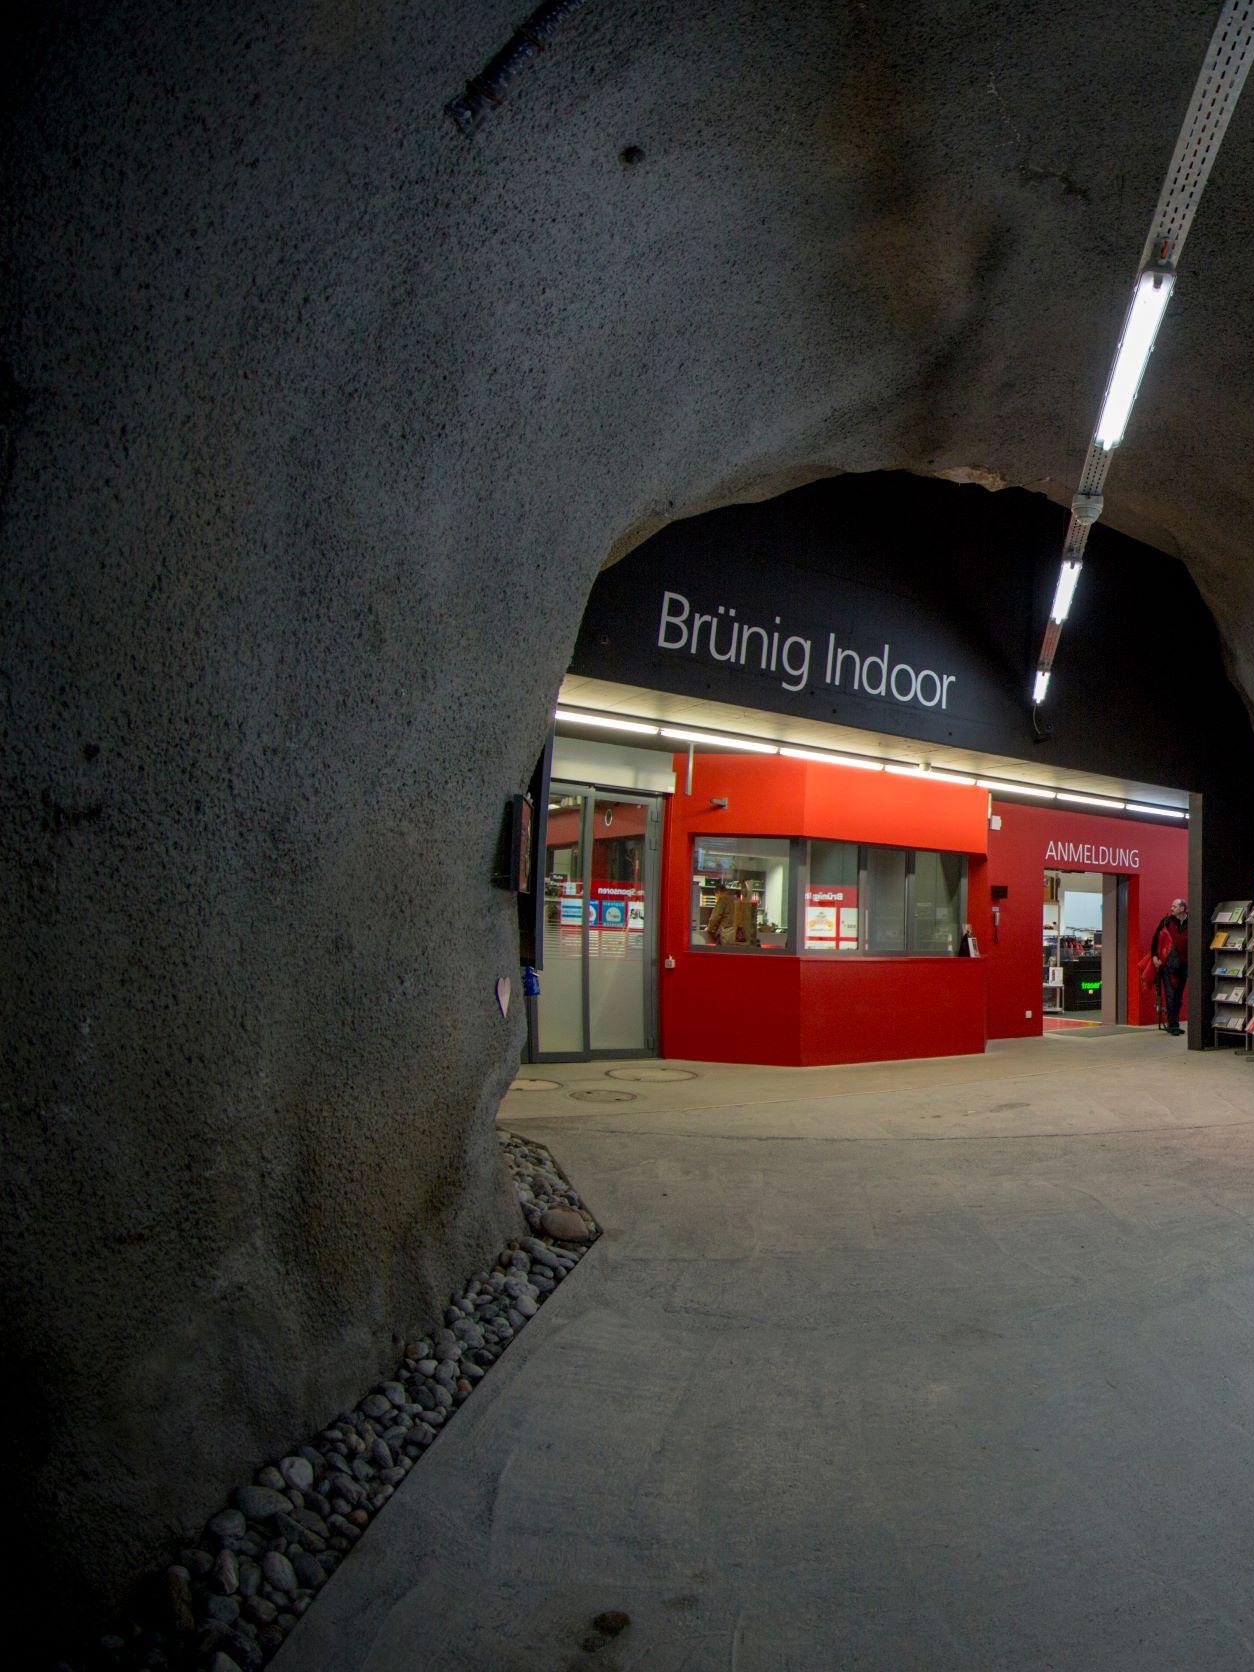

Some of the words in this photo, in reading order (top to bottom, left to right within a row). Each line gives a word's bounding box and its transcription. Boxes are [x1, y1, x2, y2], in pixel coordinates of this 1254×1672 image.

[657, 591, 811, 691] Brünig
[825, 633, 955, 709] Indoor
[1045, 841, 1139, 868] ANMELDUNG
